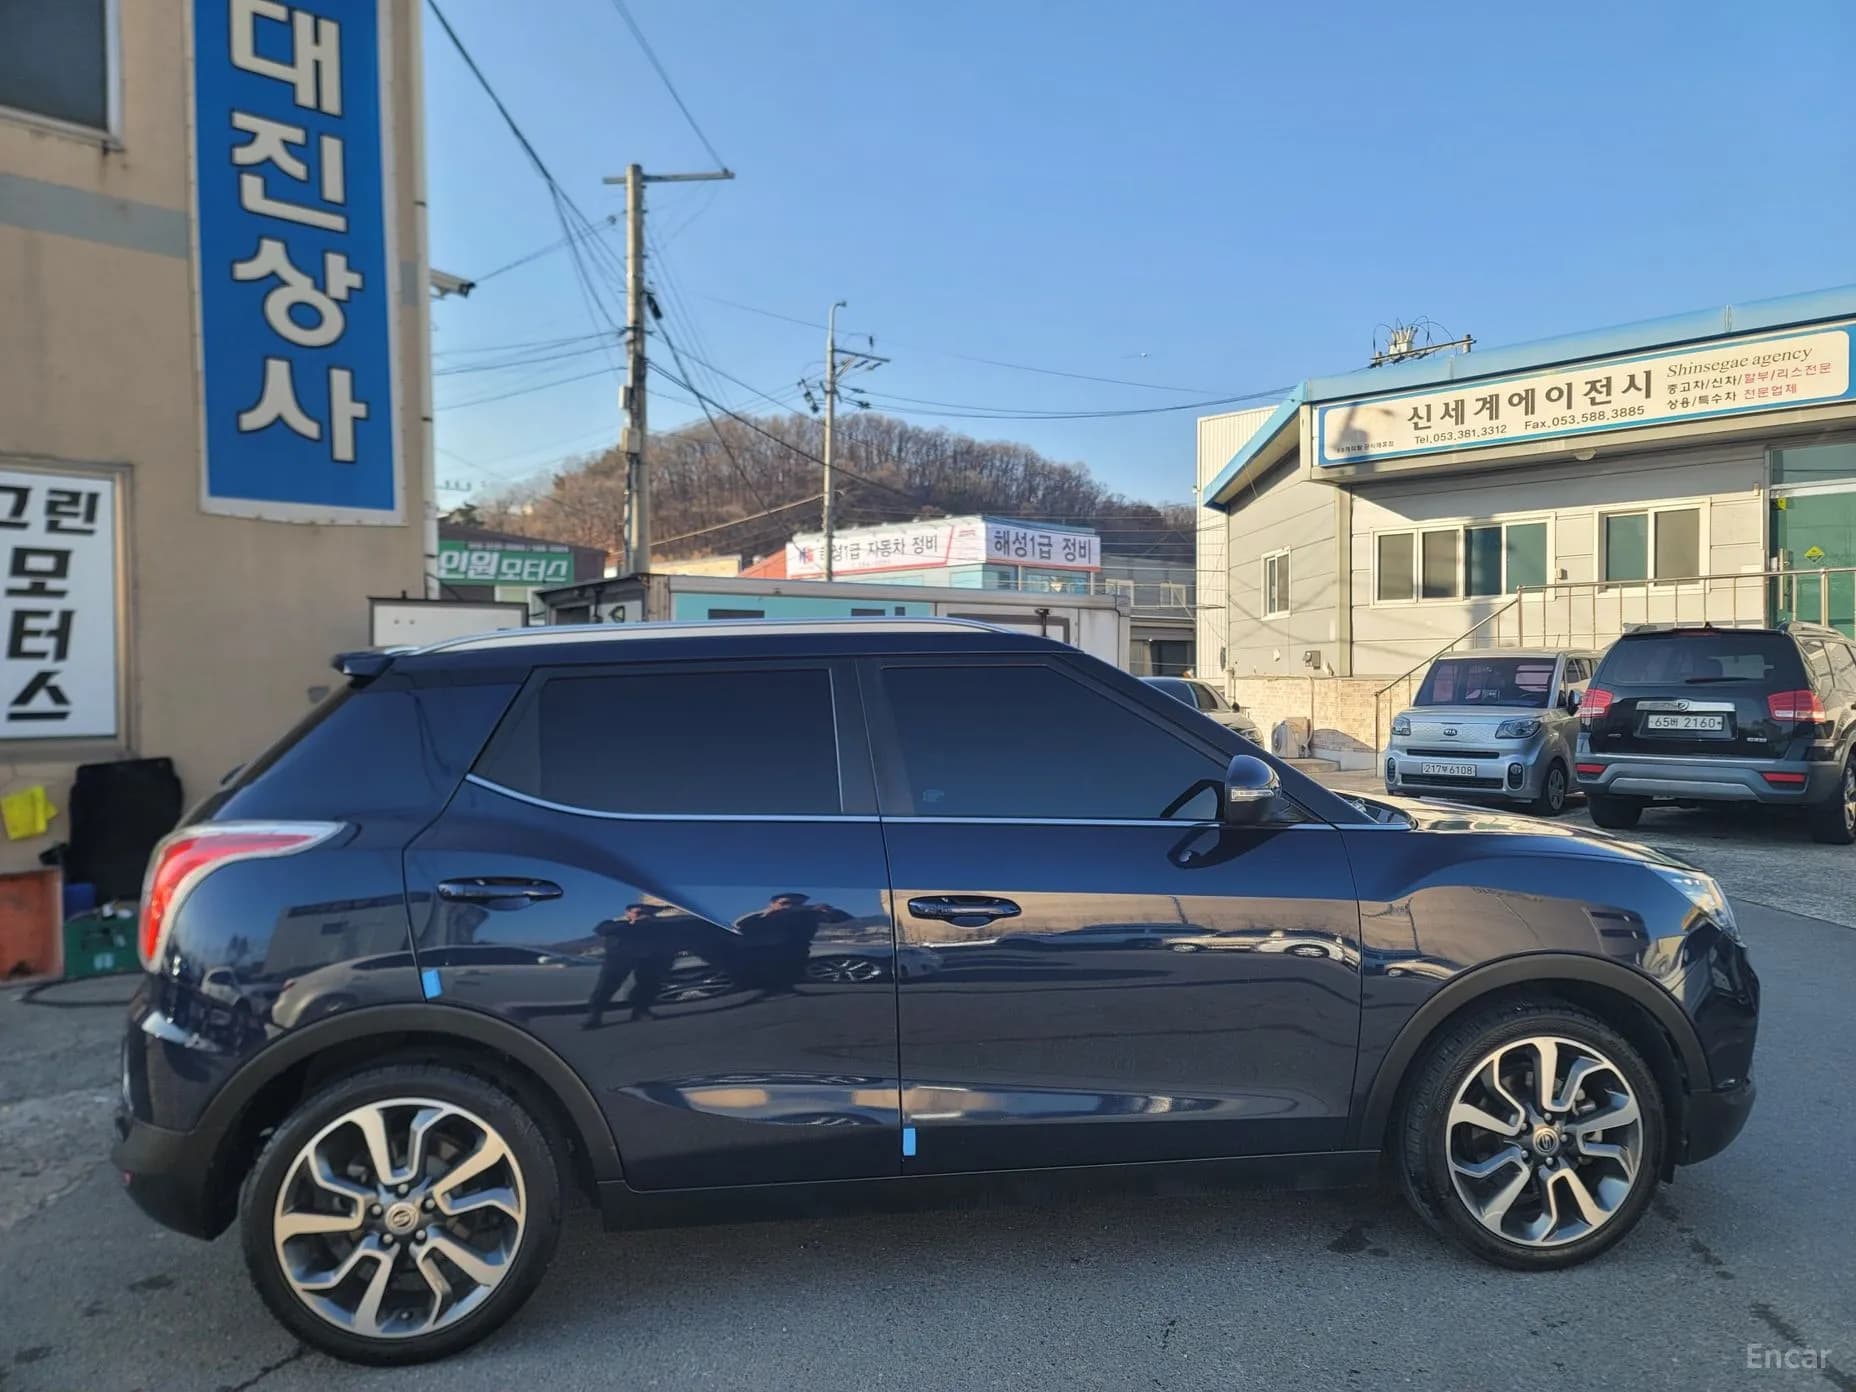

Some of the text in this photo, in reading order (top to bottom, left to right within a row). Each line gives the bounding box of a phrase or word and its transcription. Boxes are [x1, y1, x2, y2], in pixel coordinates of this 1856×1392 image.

[229, 0, 369, 464] 대진상사
[1667, 347, 1813, 377] Shinsegae agency
[1408, 370, 1652, 431] 신세계에이전시
[0, 485, 100, 536] 그린
[868, 538, 905, 558] 자동차
[912, 535, 937, 555] 정비
[994, 530, 1091, 564] 해성1급 정비
[5, 547, 76, 722] 모터스
